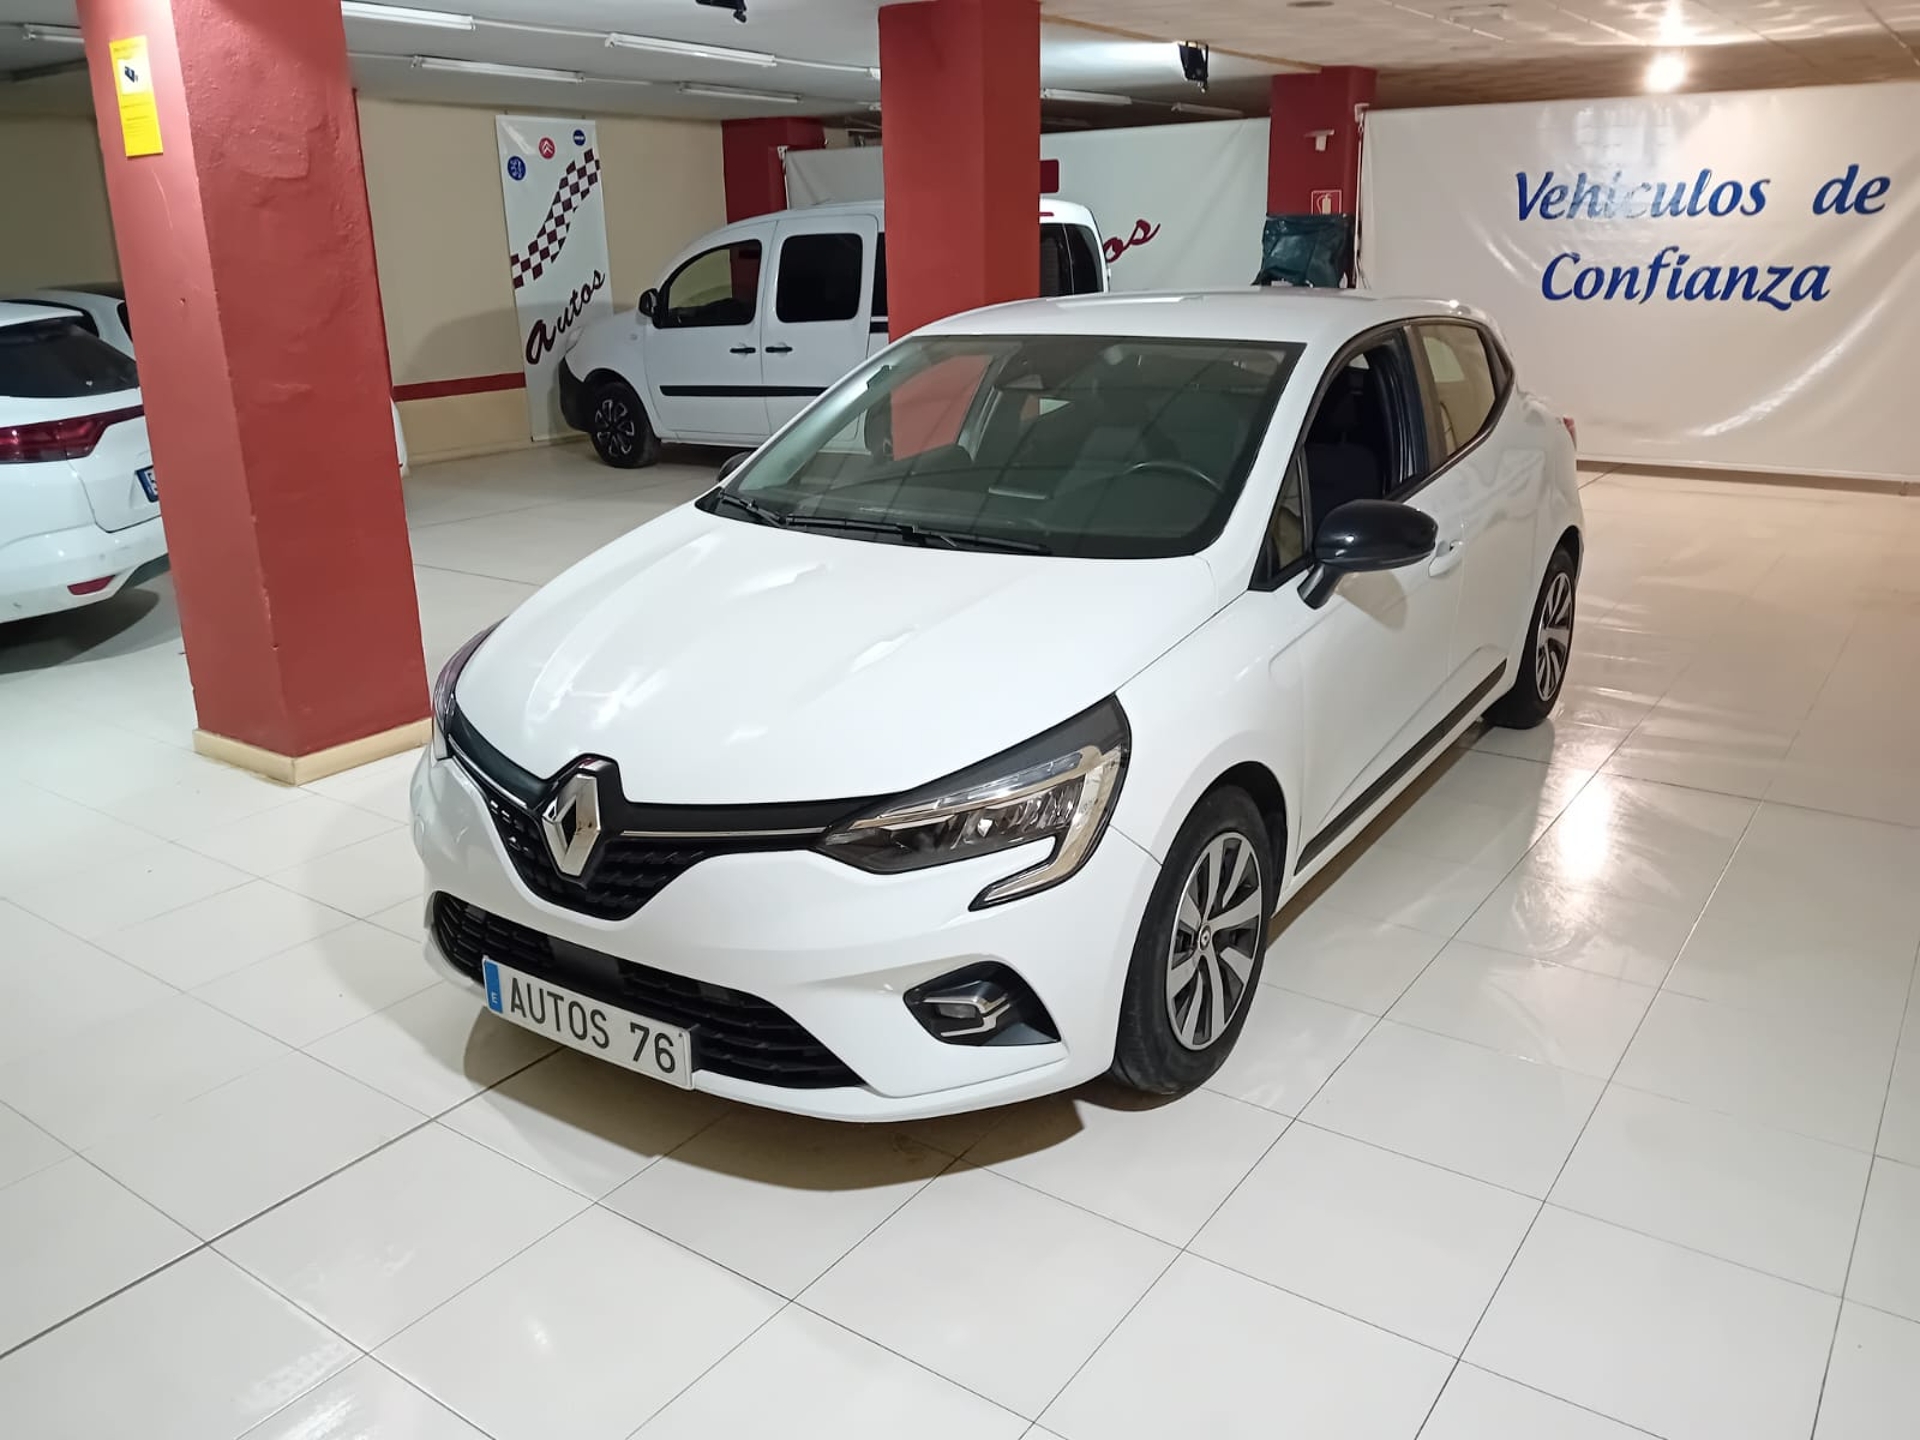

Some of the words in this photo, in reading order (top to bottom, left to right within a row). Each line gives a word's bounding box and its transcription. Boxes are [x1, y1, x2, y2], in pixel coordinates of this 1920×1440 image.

[1812, 164, 1891, 215] de
[1541, 245, 1831, 311] Confianza
[510, 977, 610, 1050] AUTOS
[629, 1021, 677, 1074] 76
